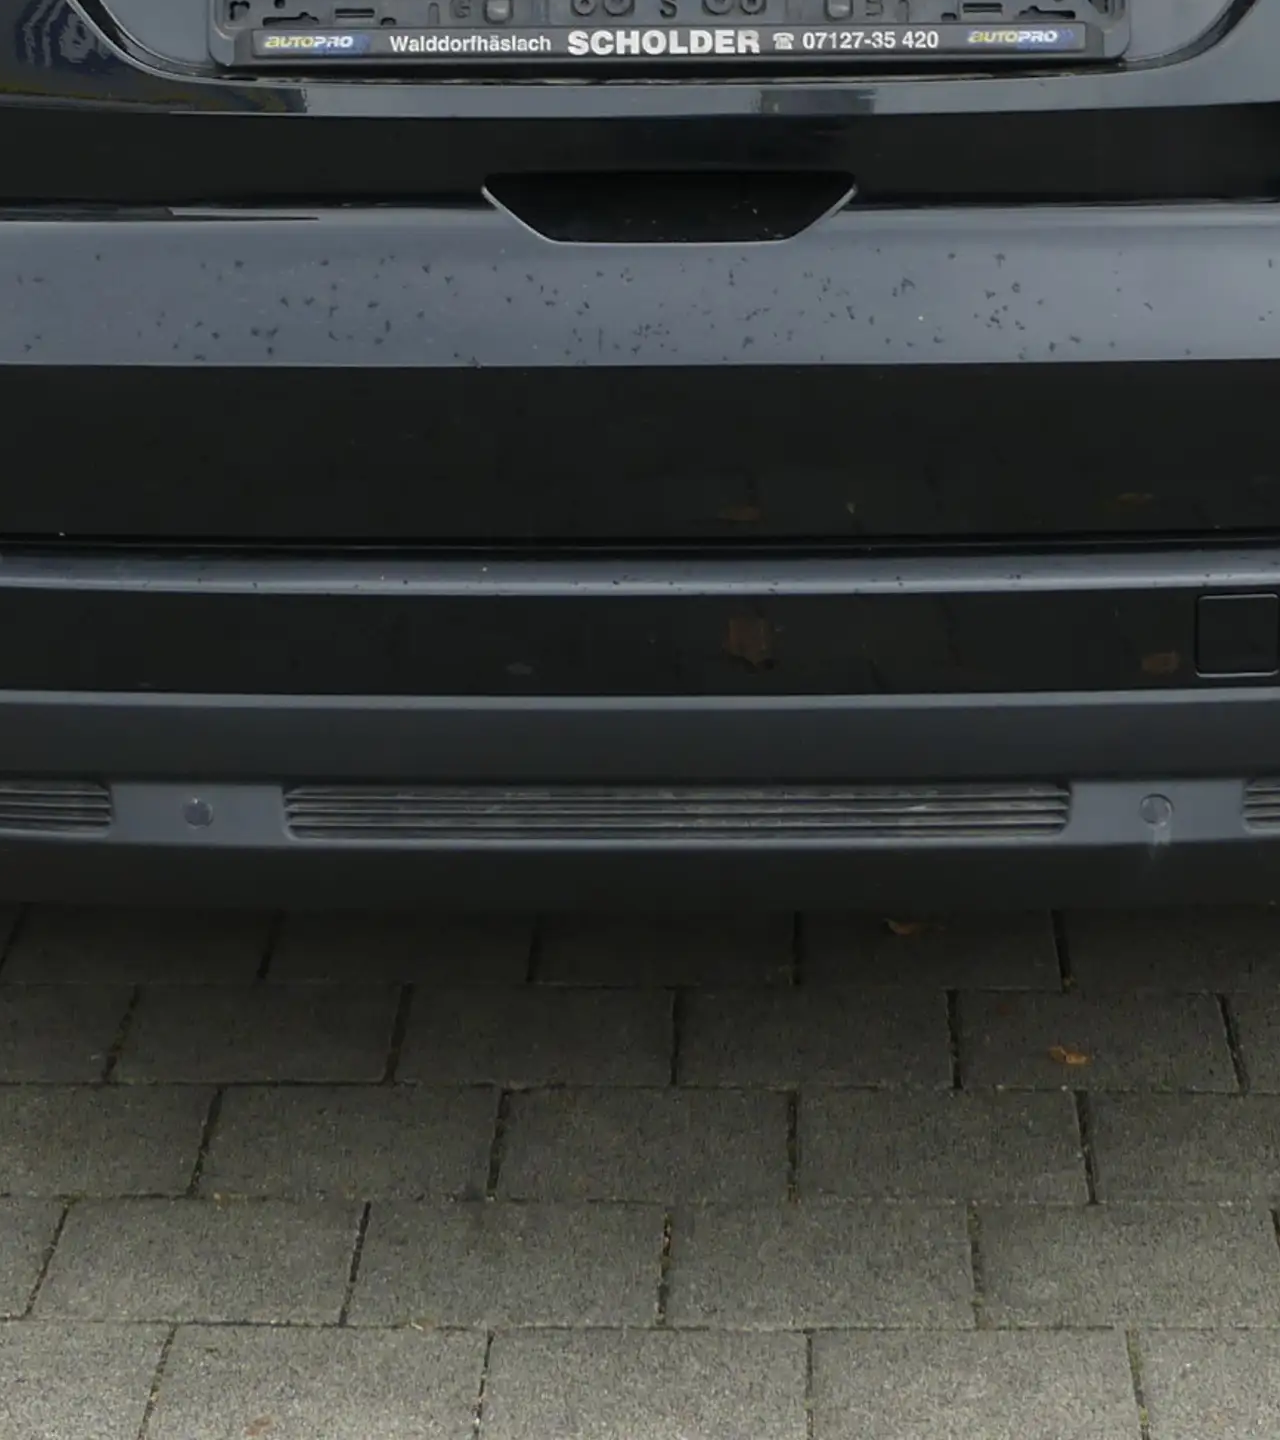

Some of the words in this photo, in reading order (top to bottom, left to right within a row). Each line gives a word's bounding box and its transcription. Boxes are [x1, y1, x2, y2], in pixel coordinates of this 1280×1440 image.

[389, 34, 552, 52] Walddorfhäslach
[567, 29, 761, 55] SCHOLDER
[802, 31, 897, 50] 07127-35
[902, 30, 940, 49] 420
